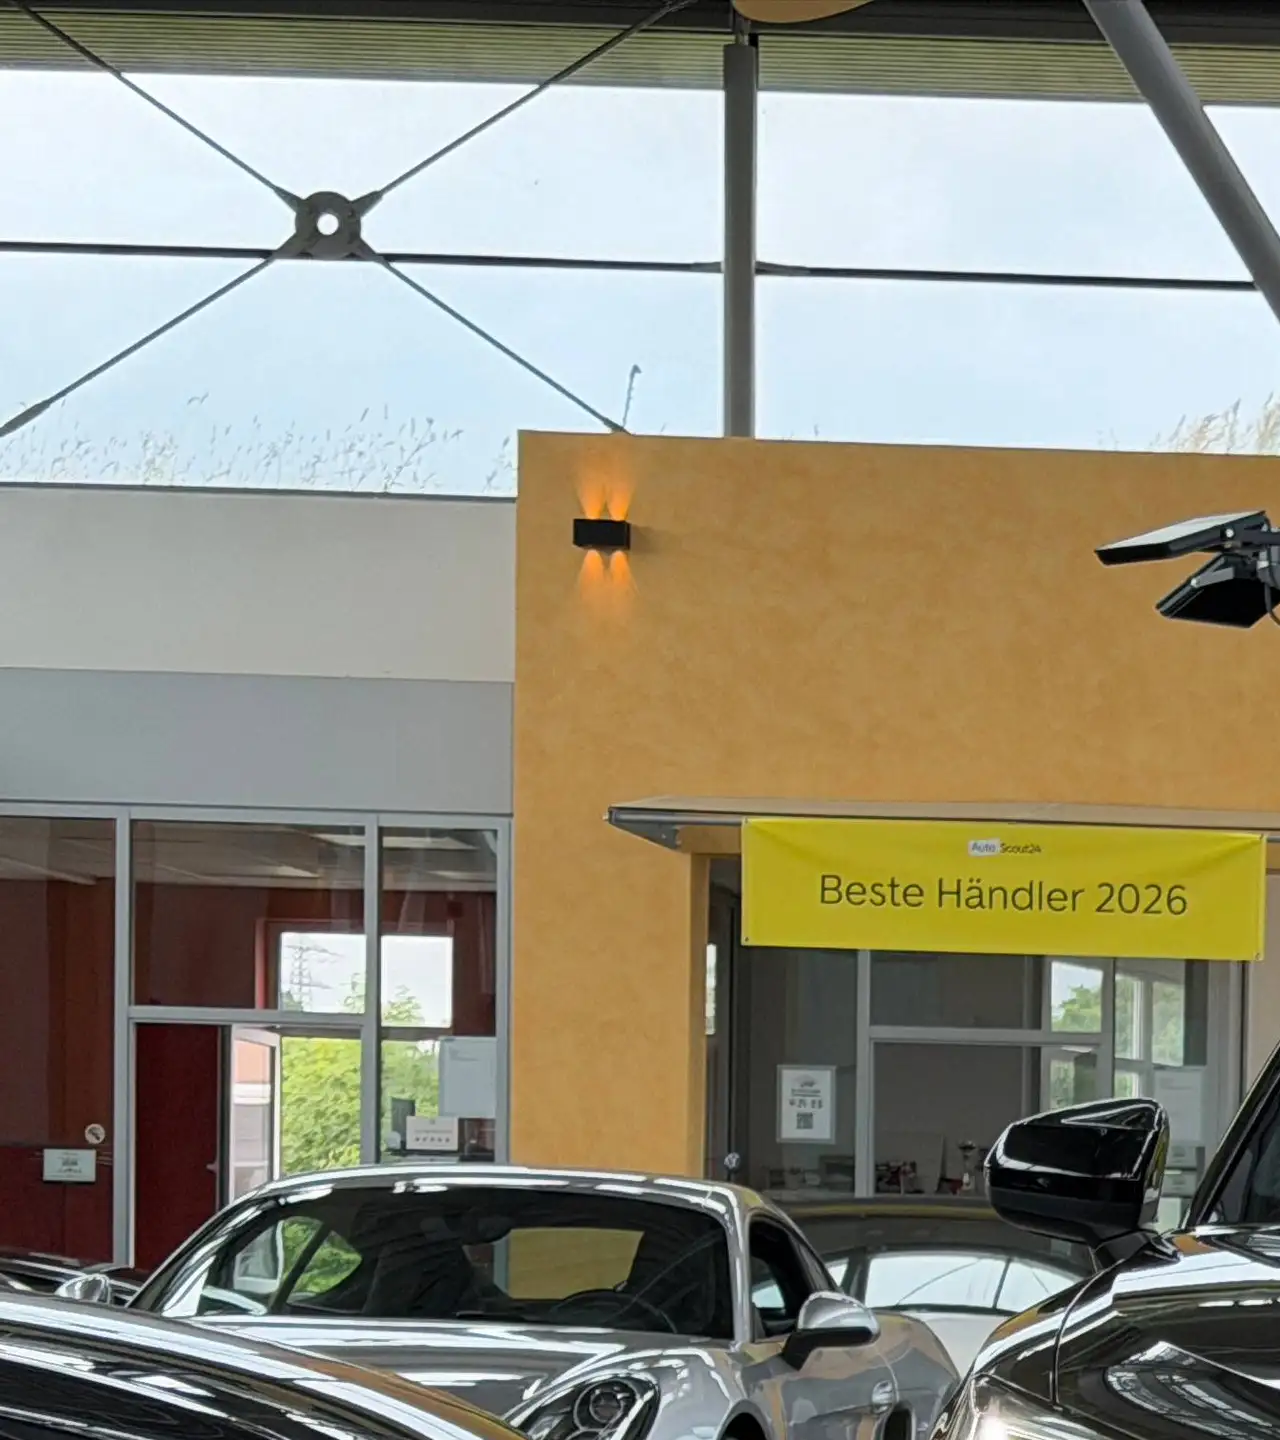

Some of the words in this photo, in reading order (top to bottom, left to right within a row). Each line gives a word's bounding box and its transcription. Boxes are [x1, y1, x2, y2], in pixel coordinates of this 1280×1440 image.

[819, 874, 925, 908] Beste
[937, 877, 1085, 912] Händler
[1094, 882, 1188, 916] 2026
